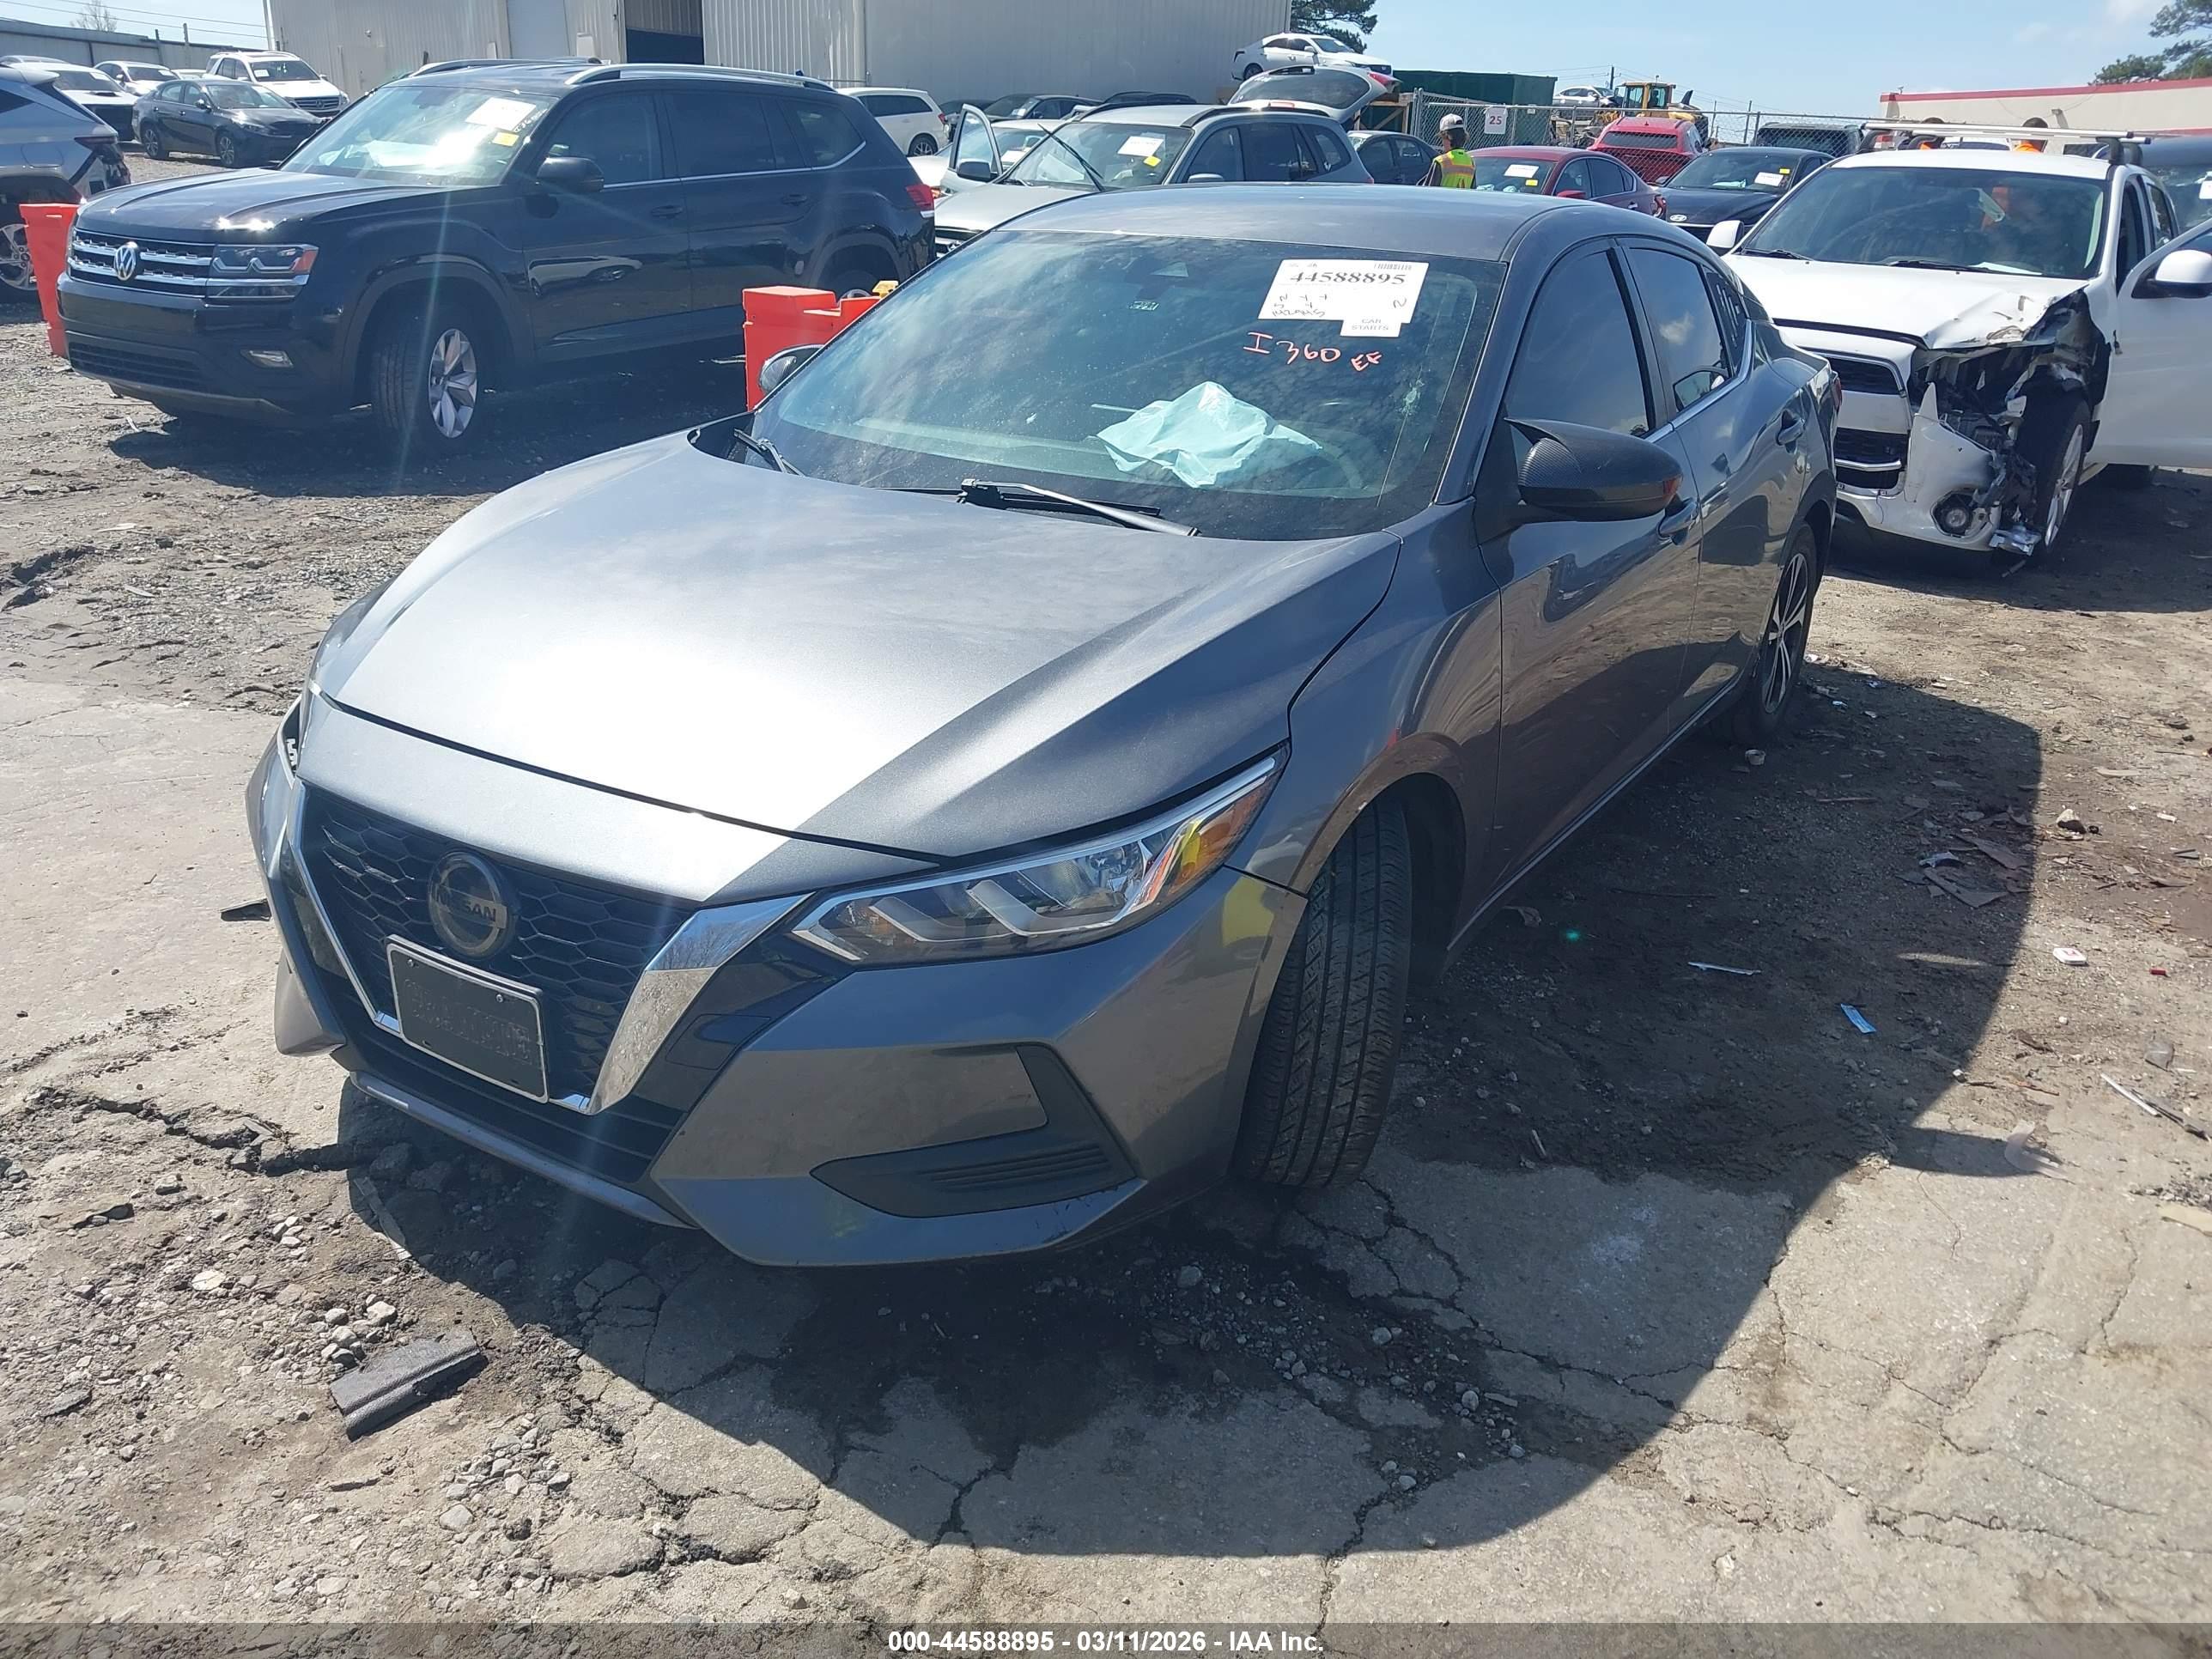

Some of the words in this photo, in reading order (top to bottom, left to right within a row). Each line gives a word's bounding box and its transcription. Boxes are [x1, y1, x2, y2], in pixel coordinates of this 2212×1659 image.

[1489, 115, 1502, 125] 25
[1290, 271, 1407, 285] 44588895
[436, 888, 497, 922] NSAN
